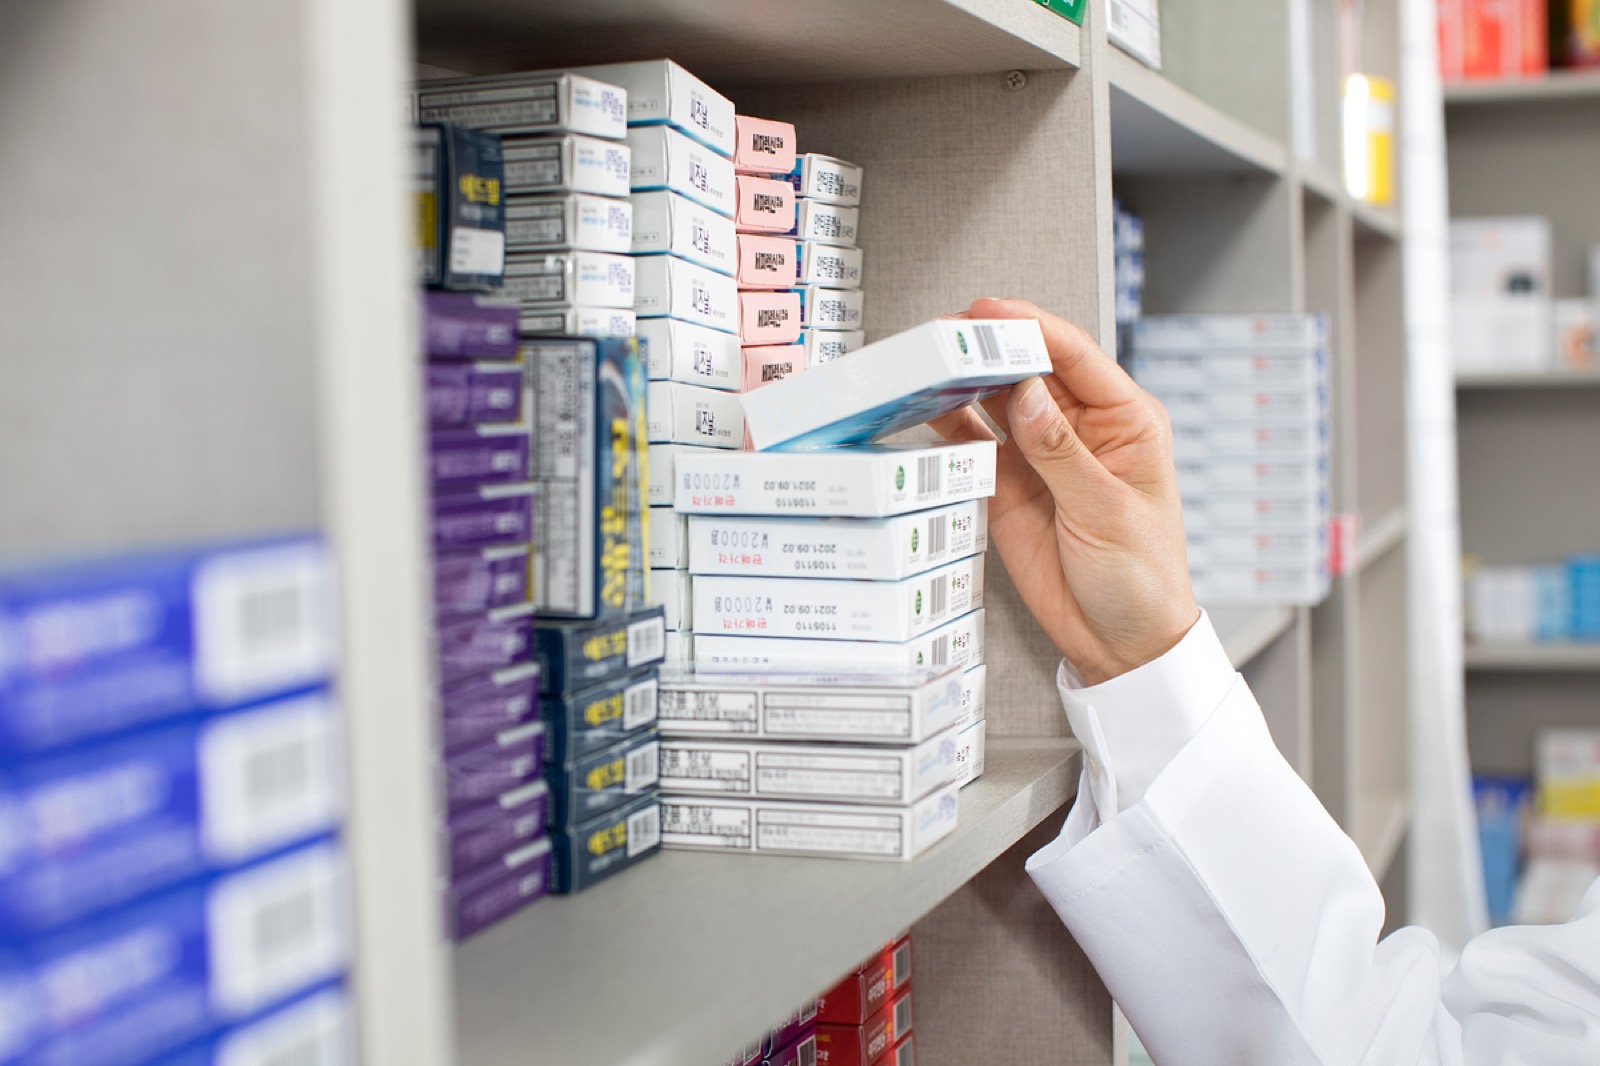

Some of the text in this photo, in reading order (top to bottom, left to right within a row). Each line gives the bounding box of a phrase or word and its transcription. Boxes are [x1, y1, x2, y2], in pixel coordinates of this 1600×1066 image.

[763, 481, 816, 491] 2021.09.02
[691, 495, 736, 507] 판매가격
[782, 543, 836, 553] 2021.09.02
[718, 552, 763, 565] 판매가격
[783, 604, 837, 615] 2021.09.02
[722, 617, 768, 629] 판매가격
